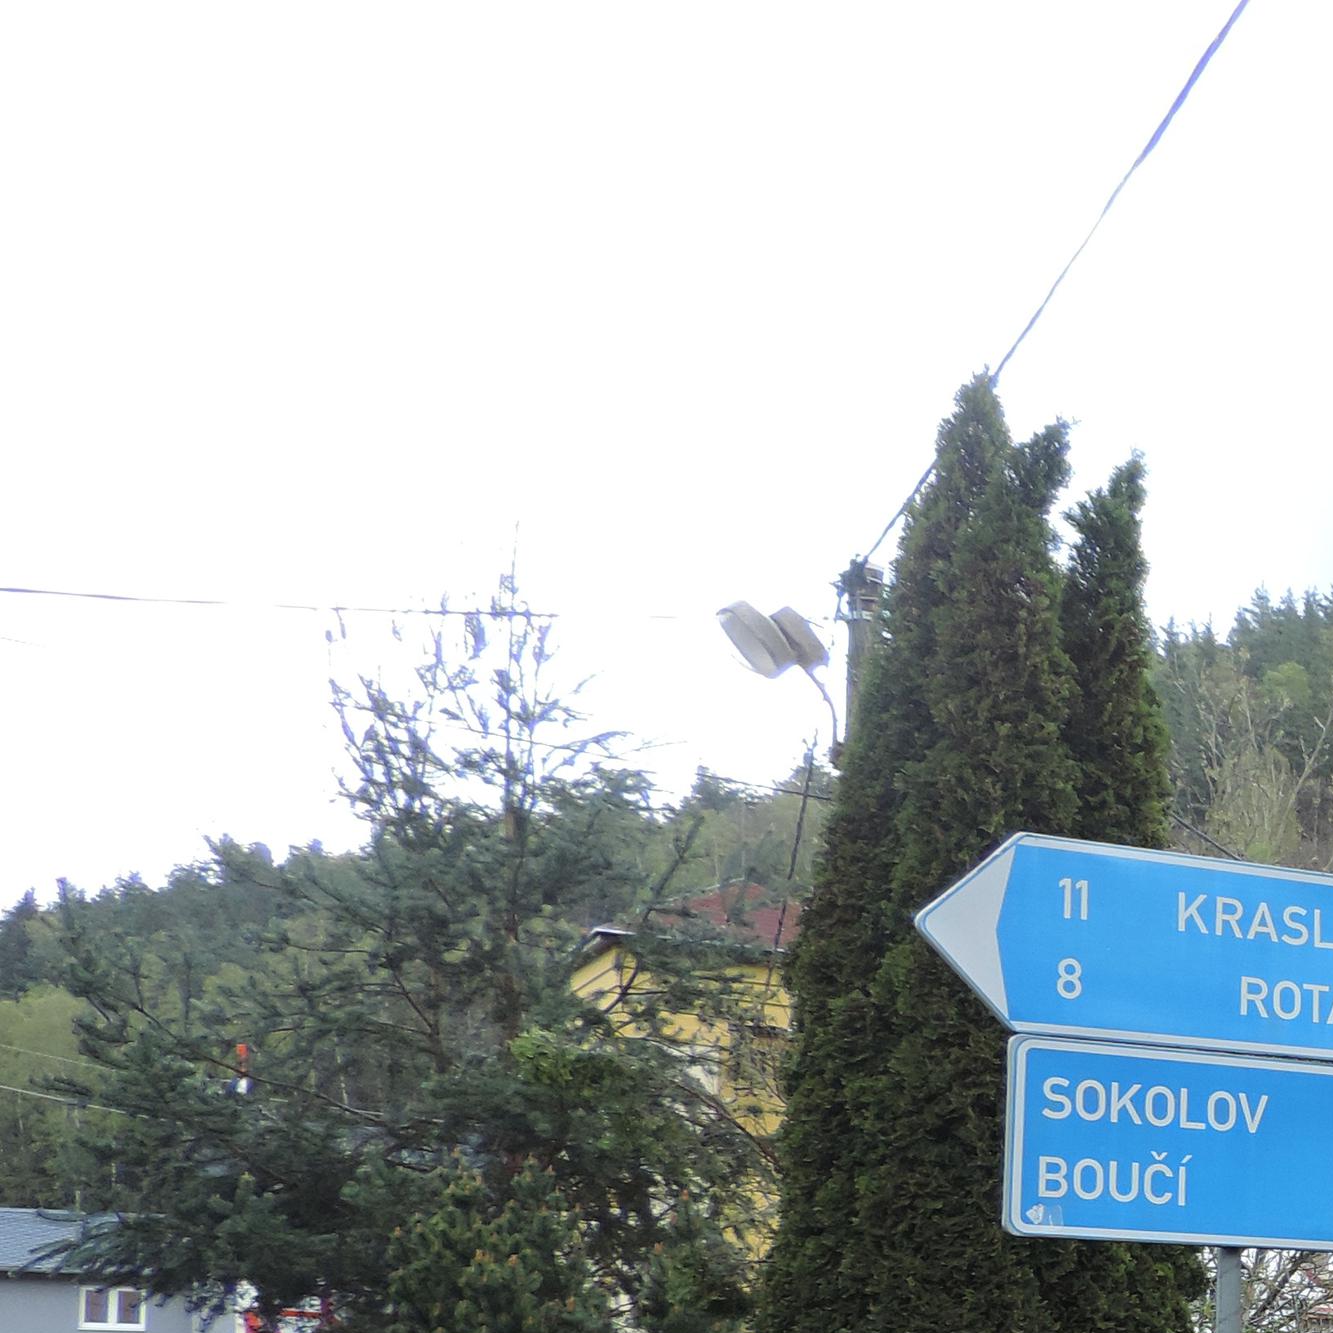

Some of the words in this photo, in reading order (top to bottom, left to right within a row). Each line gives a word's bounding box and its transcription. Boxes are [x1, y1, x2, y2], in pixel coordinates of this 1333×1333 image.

[1059, 878, 1089, 921] 11
[1057, 959, 1082, 1000] 8
[1042, 1077, 1268, 1134] SOKOLOV
[1038, 1151, 1192, 1207] BOUČÍ
